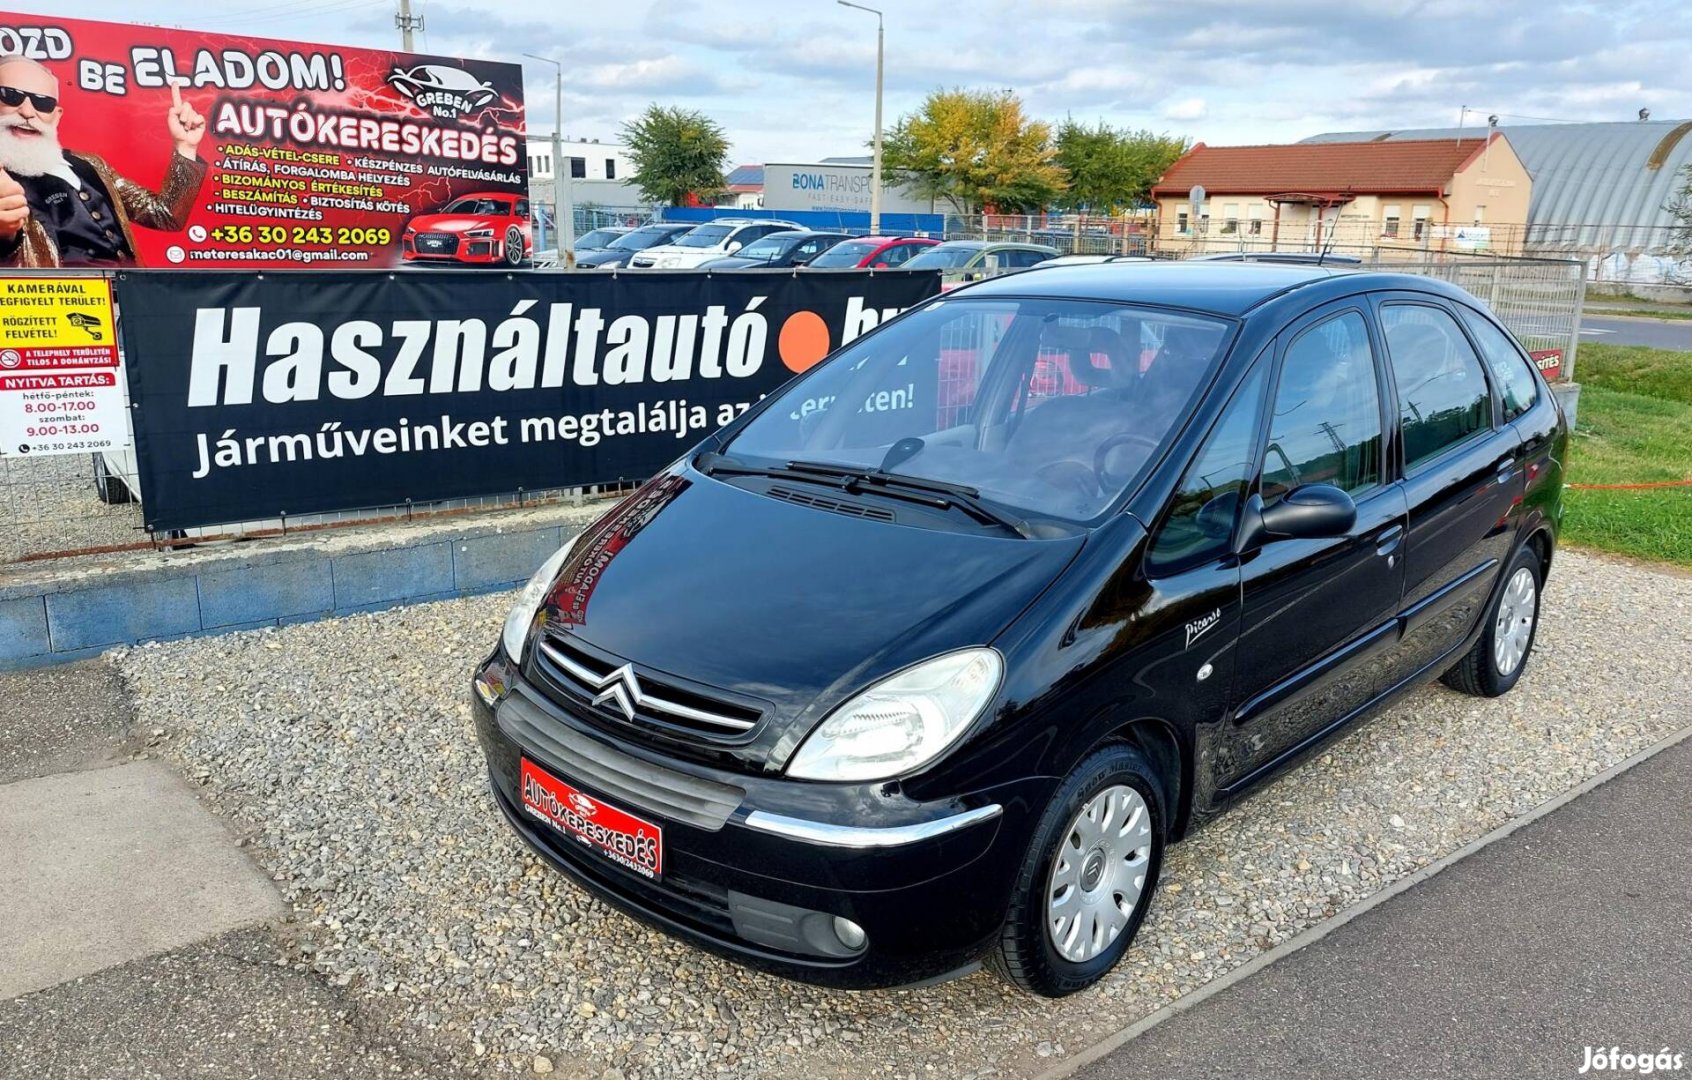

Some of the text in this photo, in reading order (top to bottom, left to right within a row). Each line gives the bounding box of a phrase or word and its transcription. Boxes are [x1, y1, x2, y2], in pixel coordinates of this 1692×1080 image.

[80, 47, 345, 95] BE ELADOM!
[416, 91, 473, 114] GREBEN
[433, 105, 457, 119] No.1
[216, 102, 518, 165] AUTÓKERESKEDÉS
[225, 145, 522, 185] ADÁS-VÉTEL-CSERE KÉSZPÉNZES AUTÓFELVÁSÁRLÁS
[222, 158, 411, 187] ÁTÍRÁS, FORGALOMBA HELYEZÉS
[221, 174, 383, 198] BIZOMÁNYOS ÉRTÉKESÍTÉS
[222, 189, 411, 214] BESZÁMÍTÁS BIZTOSÍTÁS KÖTÉS
[215, 203, 323, 221] HITELÜGYINTÉZÉS
[211, 225, 391, 246] +36 30 243 2069
[7, 282, 87, 294] KAMERÁVAL
[60, 296, 106, 306] TERÜLET!
[3, 315, 57, 326] RÖGZÍTETT
[5, 327, 58, 339] FELVÉTEL!
[33, 349, 71, 357] TELEPHELY
[27, 358, 50, 366] TILOS
[5, 374, 110, 389] NYITVA TARTÁS:
[23, 390, 95, 400] hétfő-péntek:
[25, 401, 96, 414] 8.00-17.00
[39, 414, 86, 423] szombat:
[26, 423, 100, 437] 9.00-13.00
[192, 415, 509, 479] Járműveinket
[521, 394, 707, 446] megtalálja
[67, 442, 85, 450] 243
[86, 440, 111, 449] 2069
[524, 772, 657, 870] AUTÓKERESKEDÉS
